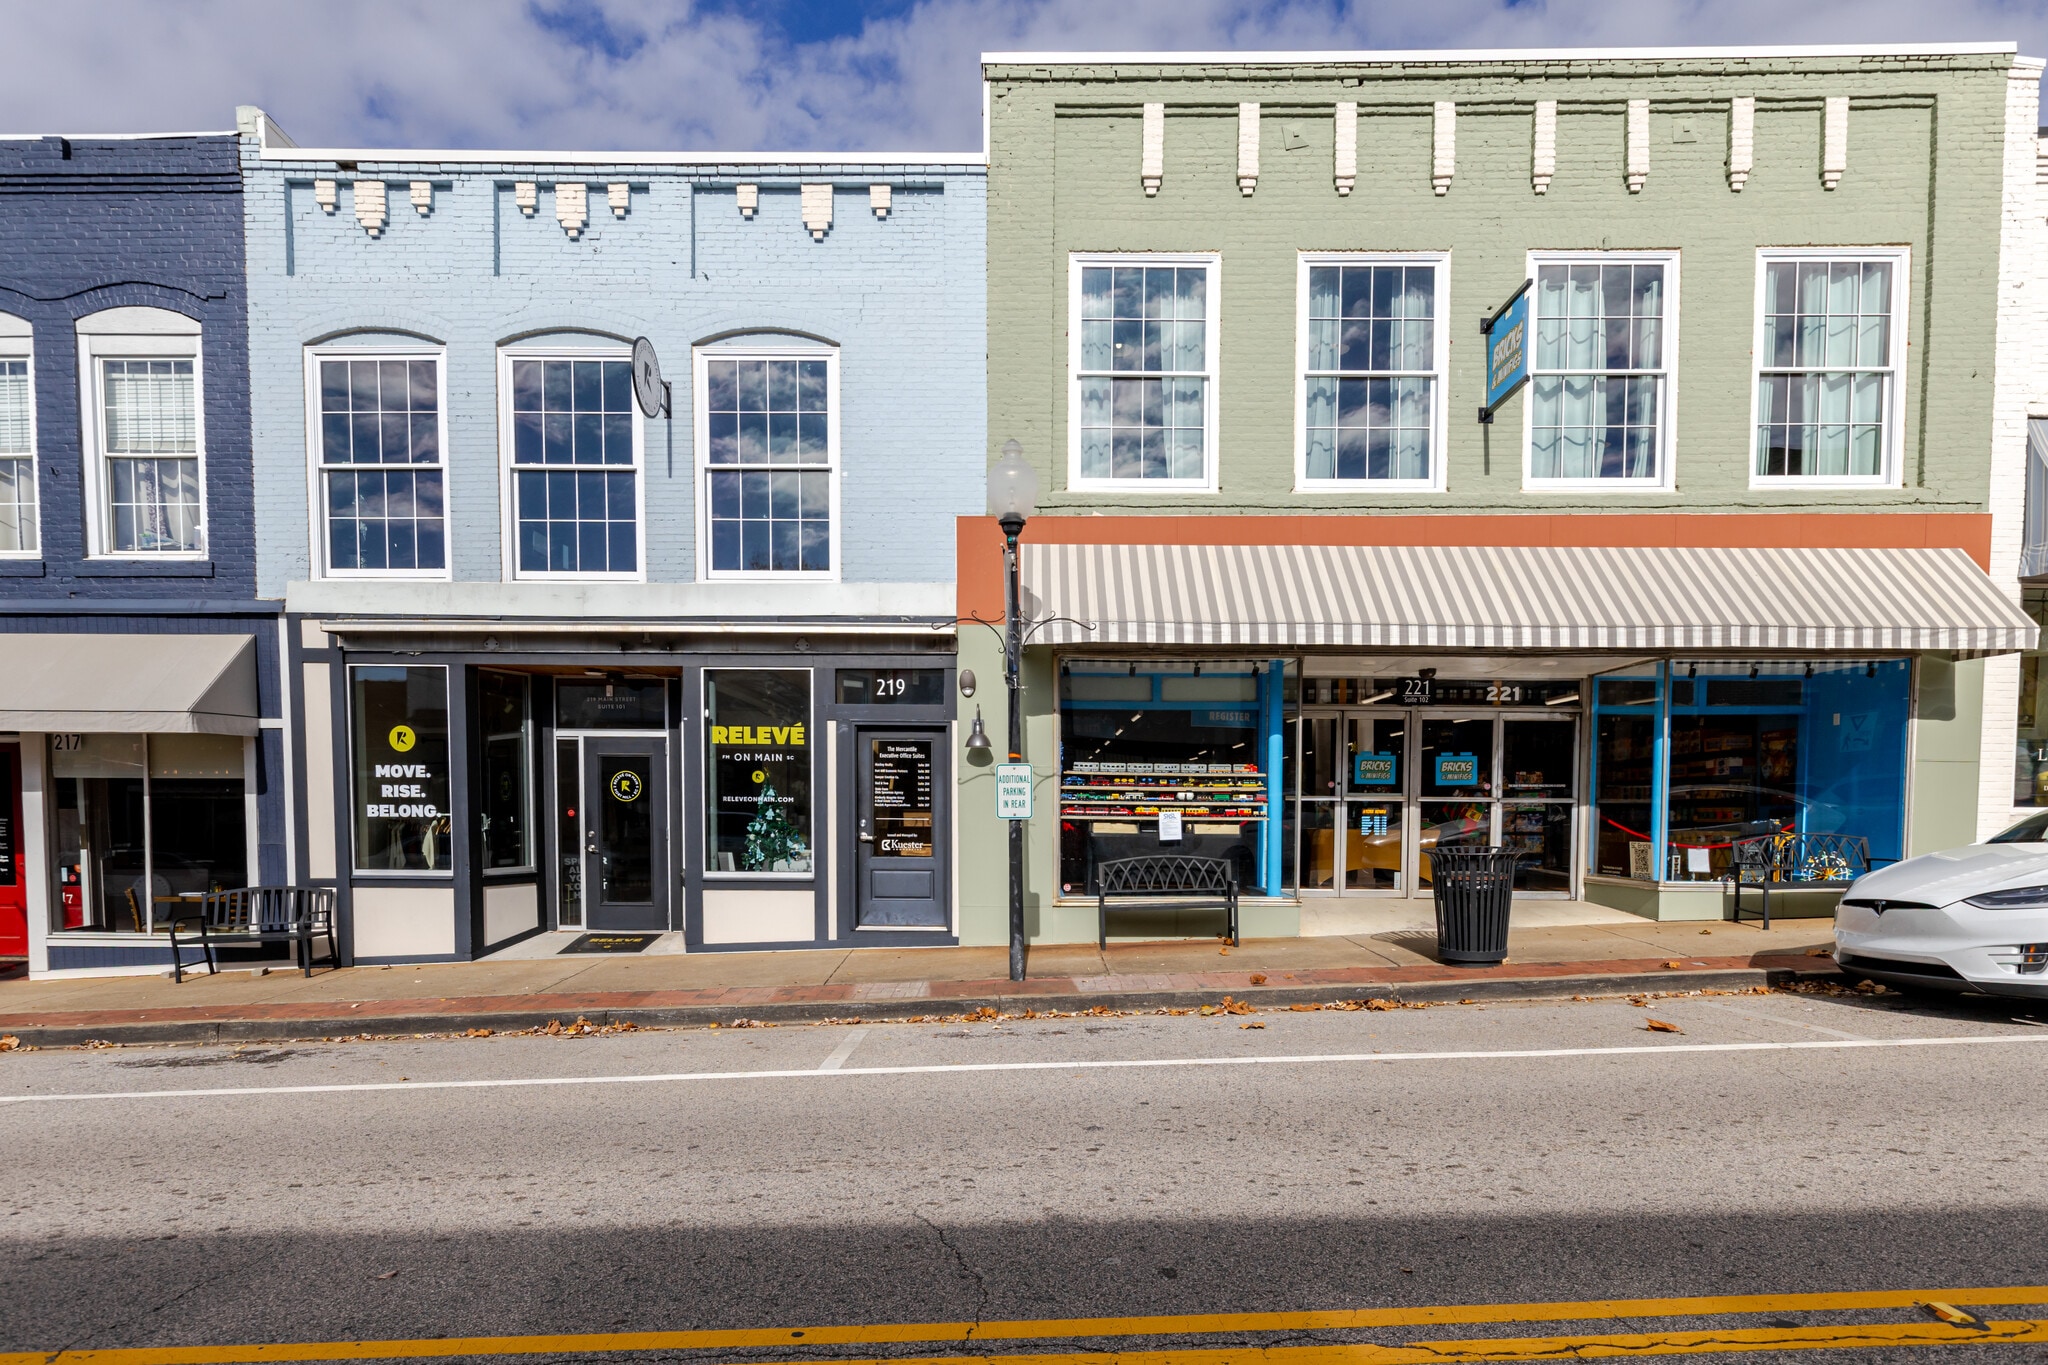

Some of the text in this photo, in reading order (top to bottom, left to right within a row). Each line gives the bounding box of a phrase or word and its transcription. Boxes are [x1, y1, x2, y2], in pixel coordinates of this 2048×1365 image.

[1492, 319, 1524, 373] BRICKS
[876, 678, 905, 696] 219
[1404, 680, 1430, 695] 221
[1486, 686, 1520, 701] 221
[1209, 711, 1250, 721] REGISTER
[711, 722, 805, 745] RELEVÉ
[54, 734, 80, 750] 217
[734, 753, 750, 762] ON
[755, 753, 783, 762] MAIN
[375, 764, 431, 778] MOVE.
[1360, 761, 1391, 771] BRICKS
[1441, 762, 1473, 772] BRICKS
[998, 774, 1031, 784] ADDITIONAL
[381, 784, 427, 798] RISE.
[1003, 787, 1026, 796] PARKING
[366, 804, 442, 818] BELONG.
[1003, 800, 1026, 808] IN REAR
[891, 839, 924, 849] Kuester
